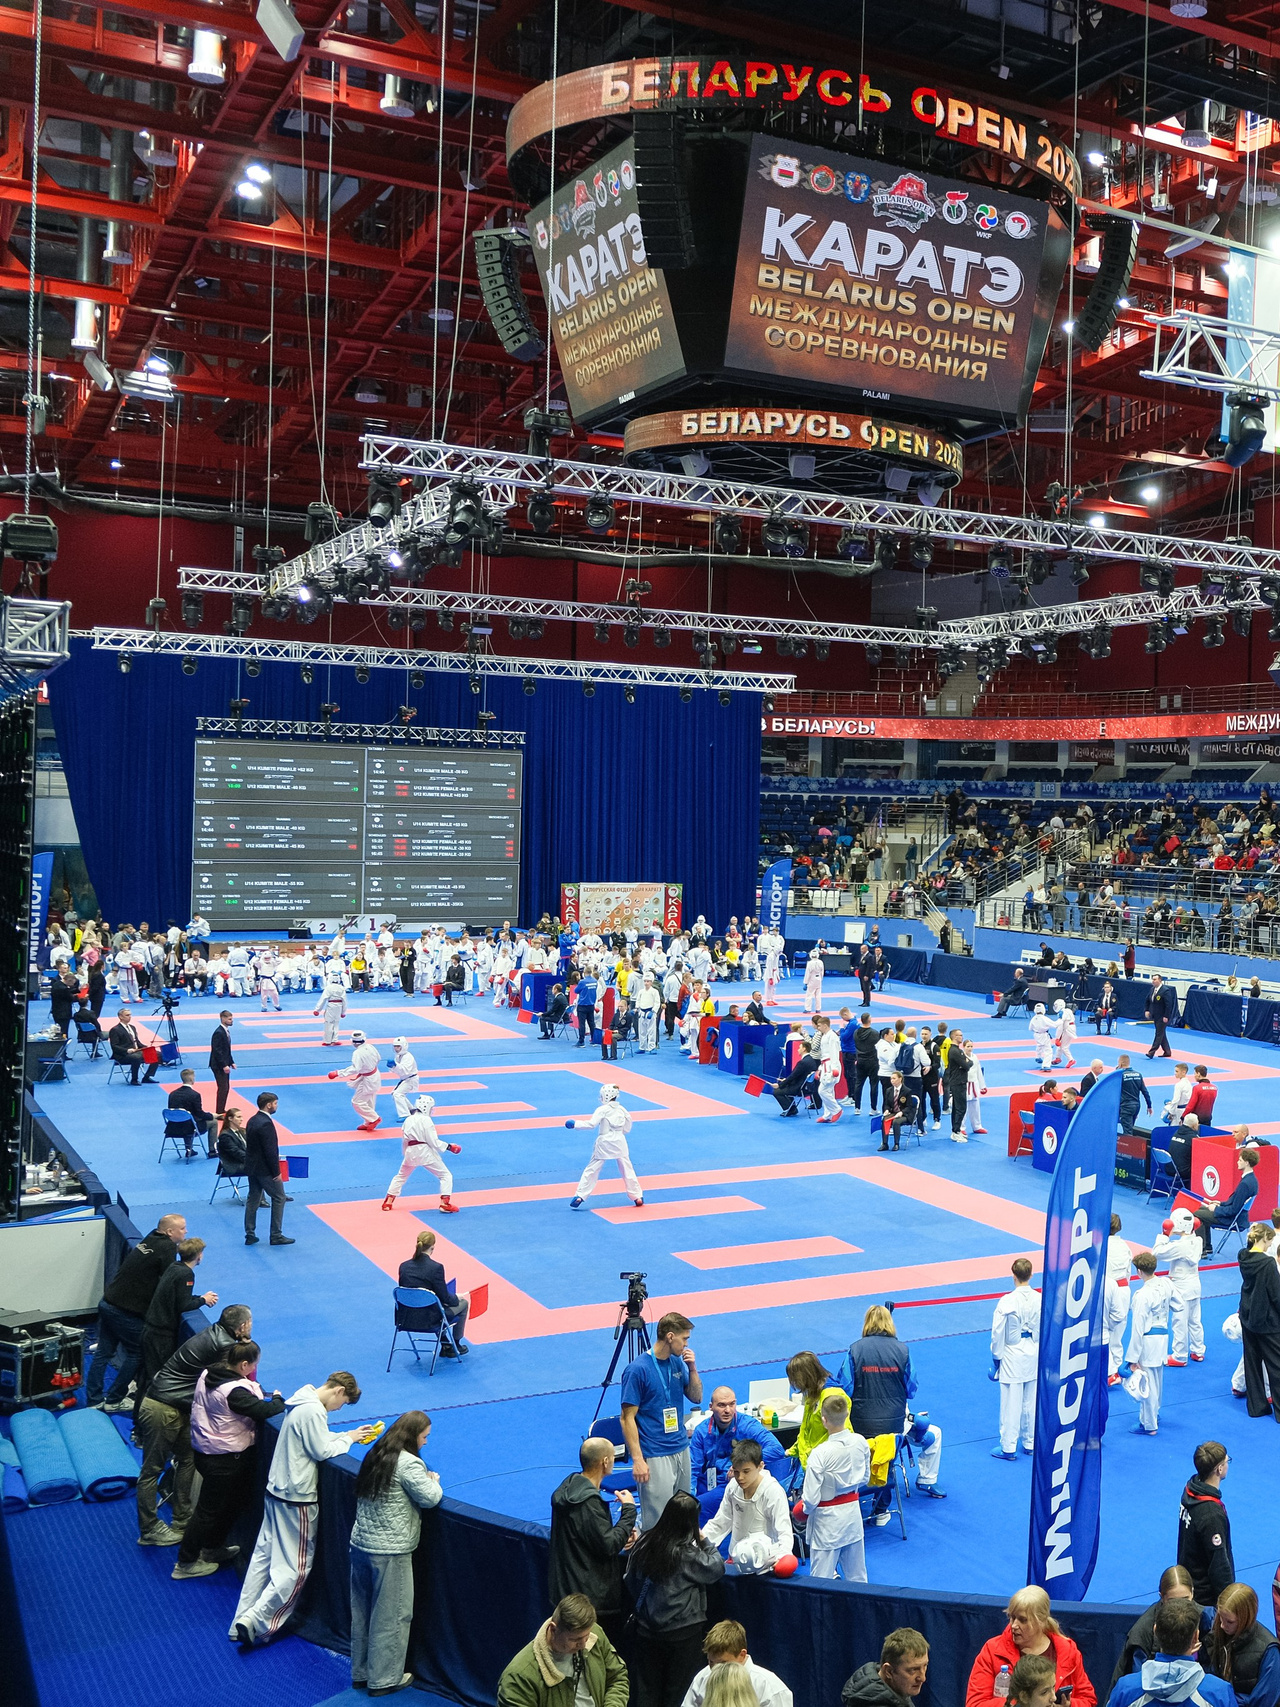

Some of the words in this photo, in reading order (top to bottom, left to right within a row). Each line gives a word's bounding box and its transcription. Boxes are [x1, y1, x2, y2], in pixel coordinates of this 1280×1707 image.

[601, 60, 892, 113] БЕЛАРУСЬ
[911, 87, 1027, 160] OPEN
[1036, 135, 1075, 195] 202
[874, 194, 911, 207] BELARUS
[911, 199, 936, 216] OPEN
[545, 212, 648, 315] КАРАТЭ
[761, 206, 1024, 306] КАРАТЭ
[976, 230, 993, 240] WKF
[558, 289, 617, 341] BELARUS
[617, 268, 658, 308] OPEN
[749, 294, 1008, 360] МЕЖДУНАРОДНЫЕ
[757, 262, 917, 316] BELARUS
[927, 299, 1016, 335] OPEN
[563, 297, 664, 368] МЕЖДУНАРОДНЫЕ
[575, 327, 662, 388] СОРЕВНОВАНИЯ
[764, 325, 988, 382] СОРЕВНОВАНИЯ
[862, 389, 890, 401] PALAMI
[681, 411, 850, 439] БЕЛАРУСЬ
[860, 419, 929, 457] OPEN
[934, 440, 959, 469] 202
[772, 717, 875, 735] БЕЛАРУСЬ!
[1042, 784, 1055, 792] 103
[319, 923, 326, 931] 2
[370, 918, 376, 931] 1
[768, 874, 783, 935] НСПОРТ
